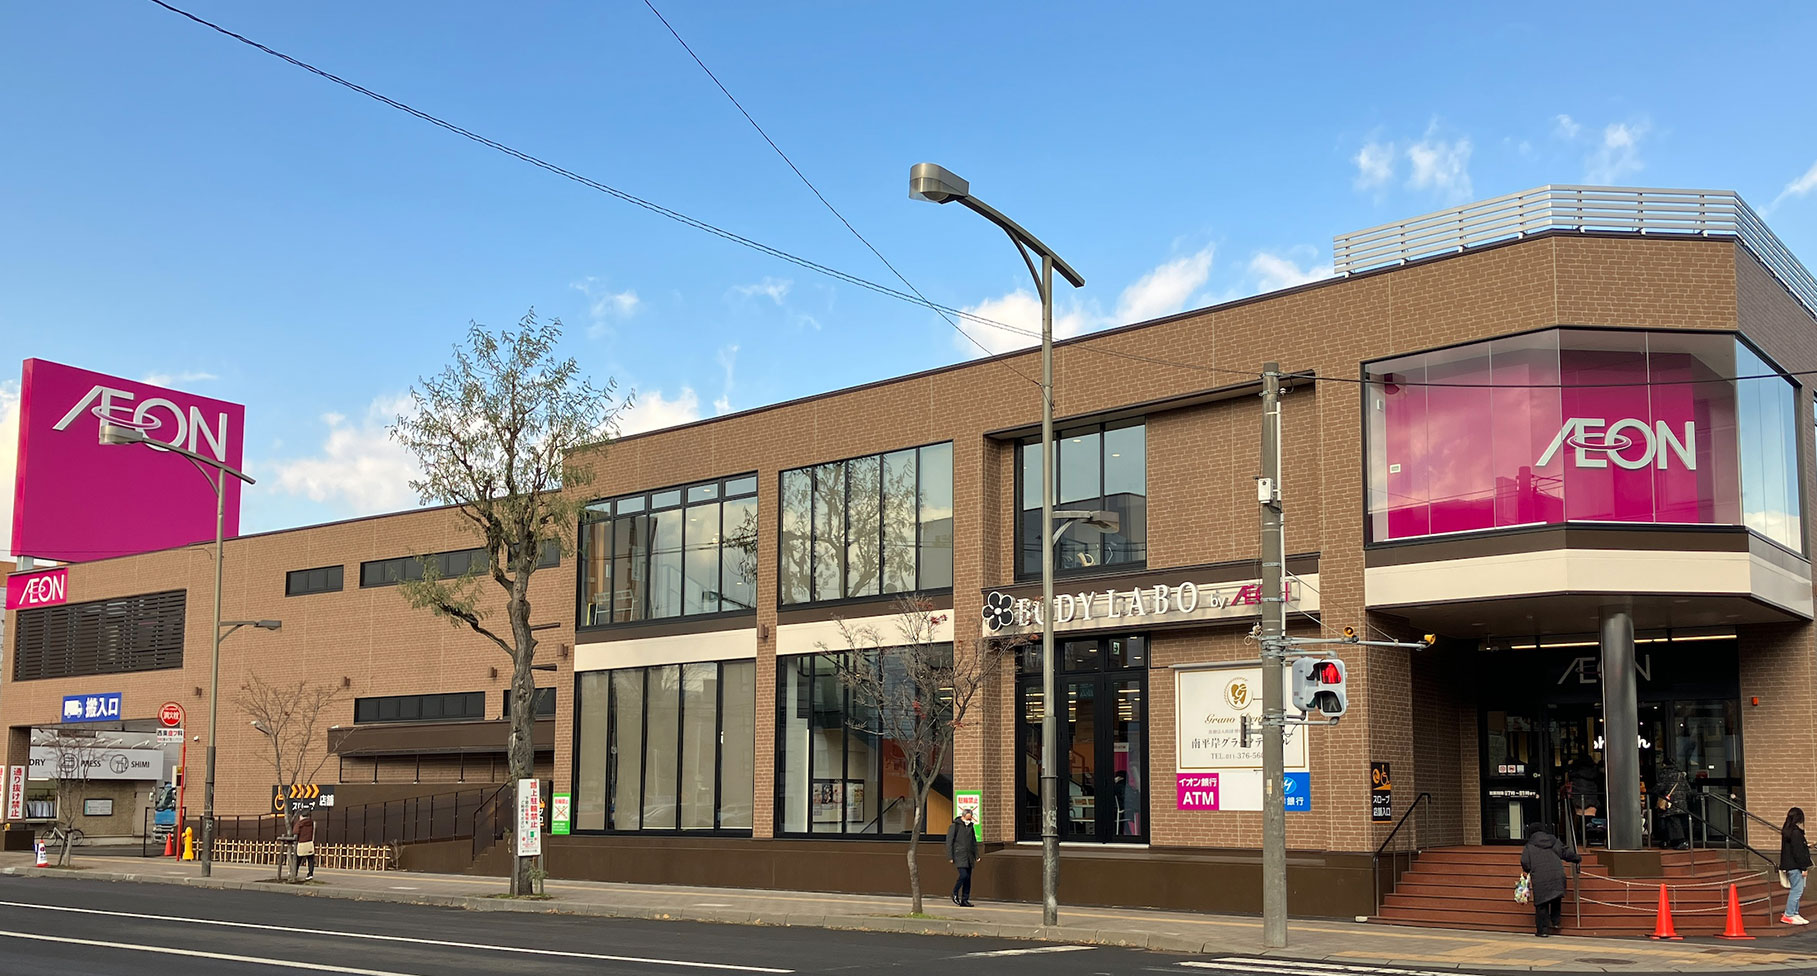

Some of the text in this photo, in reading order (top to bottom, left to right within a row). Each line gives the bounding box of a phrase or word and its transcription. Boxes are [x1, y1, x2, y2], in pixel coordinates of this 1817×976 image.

[1106, 581, 1198, 619] LABO
[1210, 594, 1226, 610] by
[85, 697, 119, 719] 搬入口
[1204, 713, 1236, 725] Grano
[1178, 777, 1218, 788] イオン銀行
[1182, 791, 1215, 806] ATM
[1284, 796, 1305, 807] 銀行
[1372, 794, 1391, 804] スロープ
